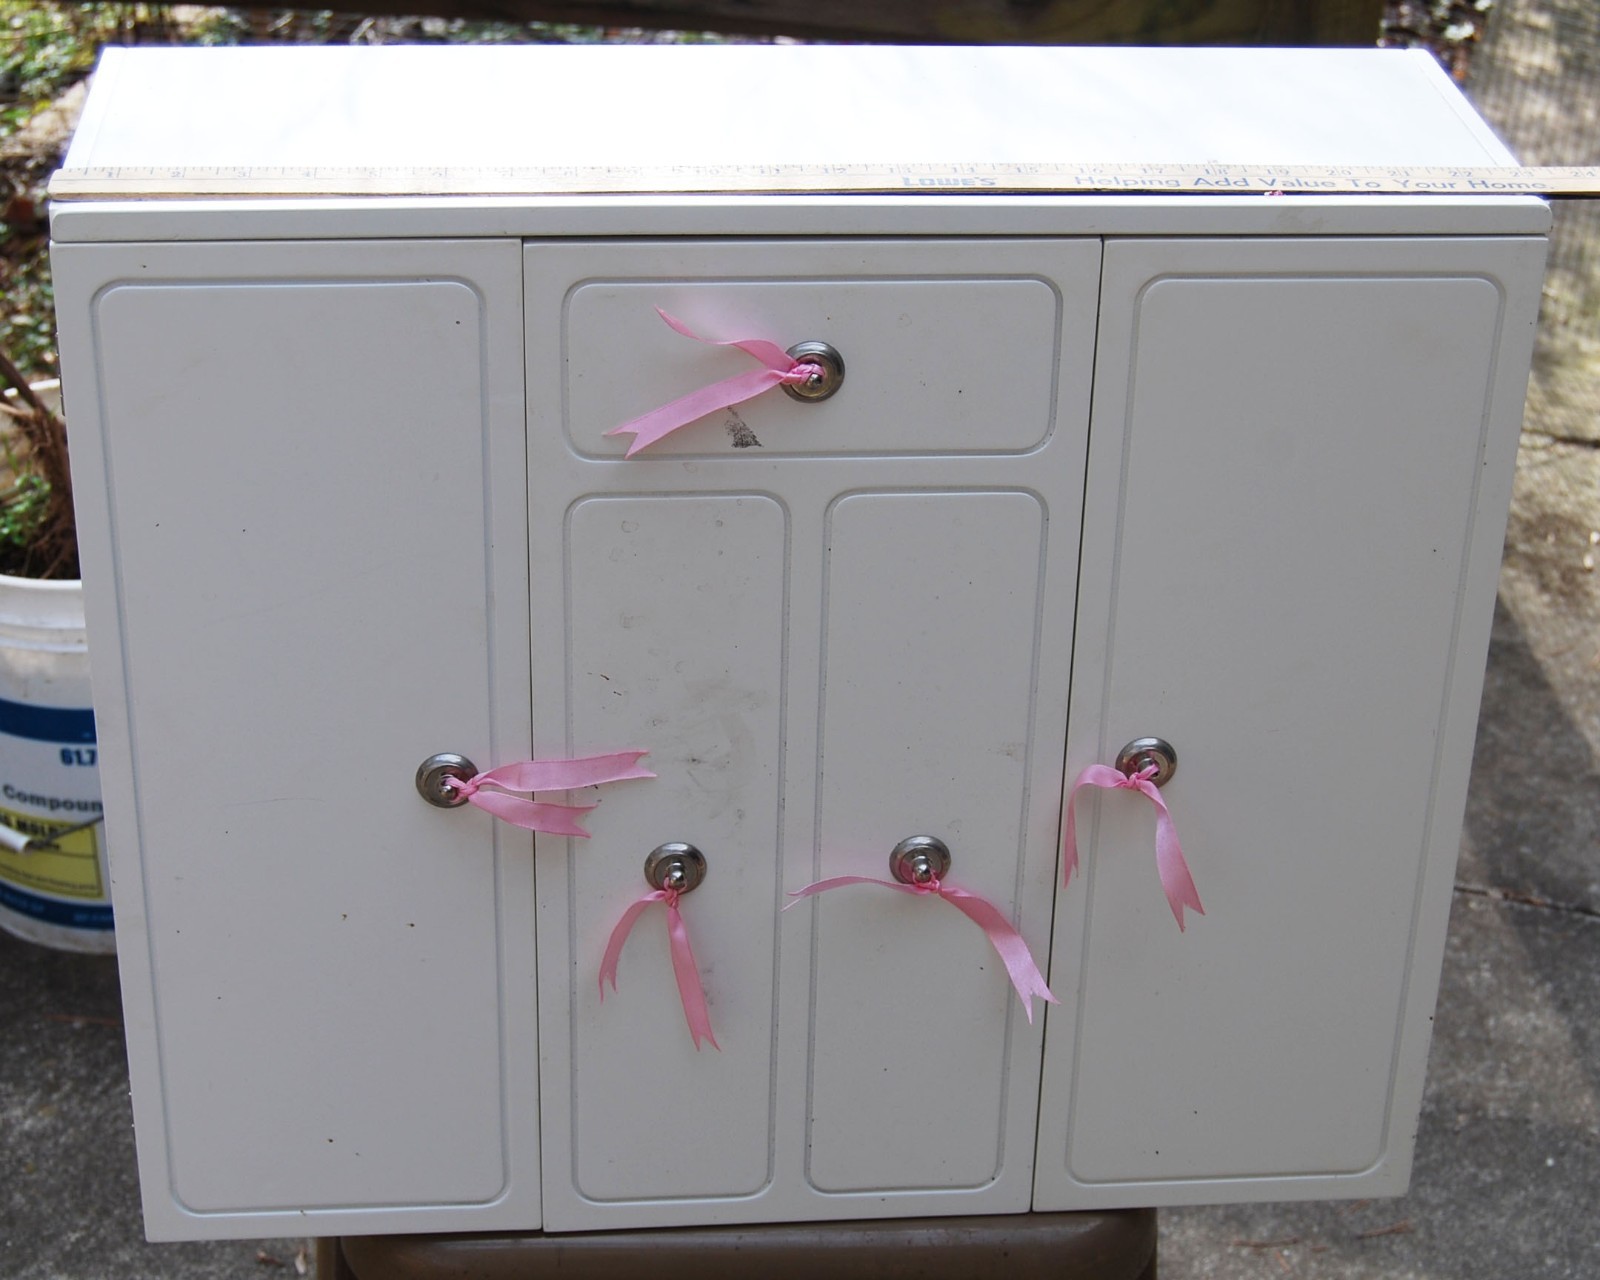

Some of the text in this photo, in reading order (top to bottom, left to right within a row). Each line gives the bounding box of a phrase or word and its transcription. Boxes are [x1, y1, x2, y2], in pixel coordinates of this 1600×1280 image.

[1074, 175, 1181, 188] Helping
[1193, 177, 1250, 187] Add
[1258, 178, 1336, 188] Value
[1345, 178, 1381, 188] To
[1392, 179, 1457, 189] Your
[2, 783, 104, 813] Compoun
